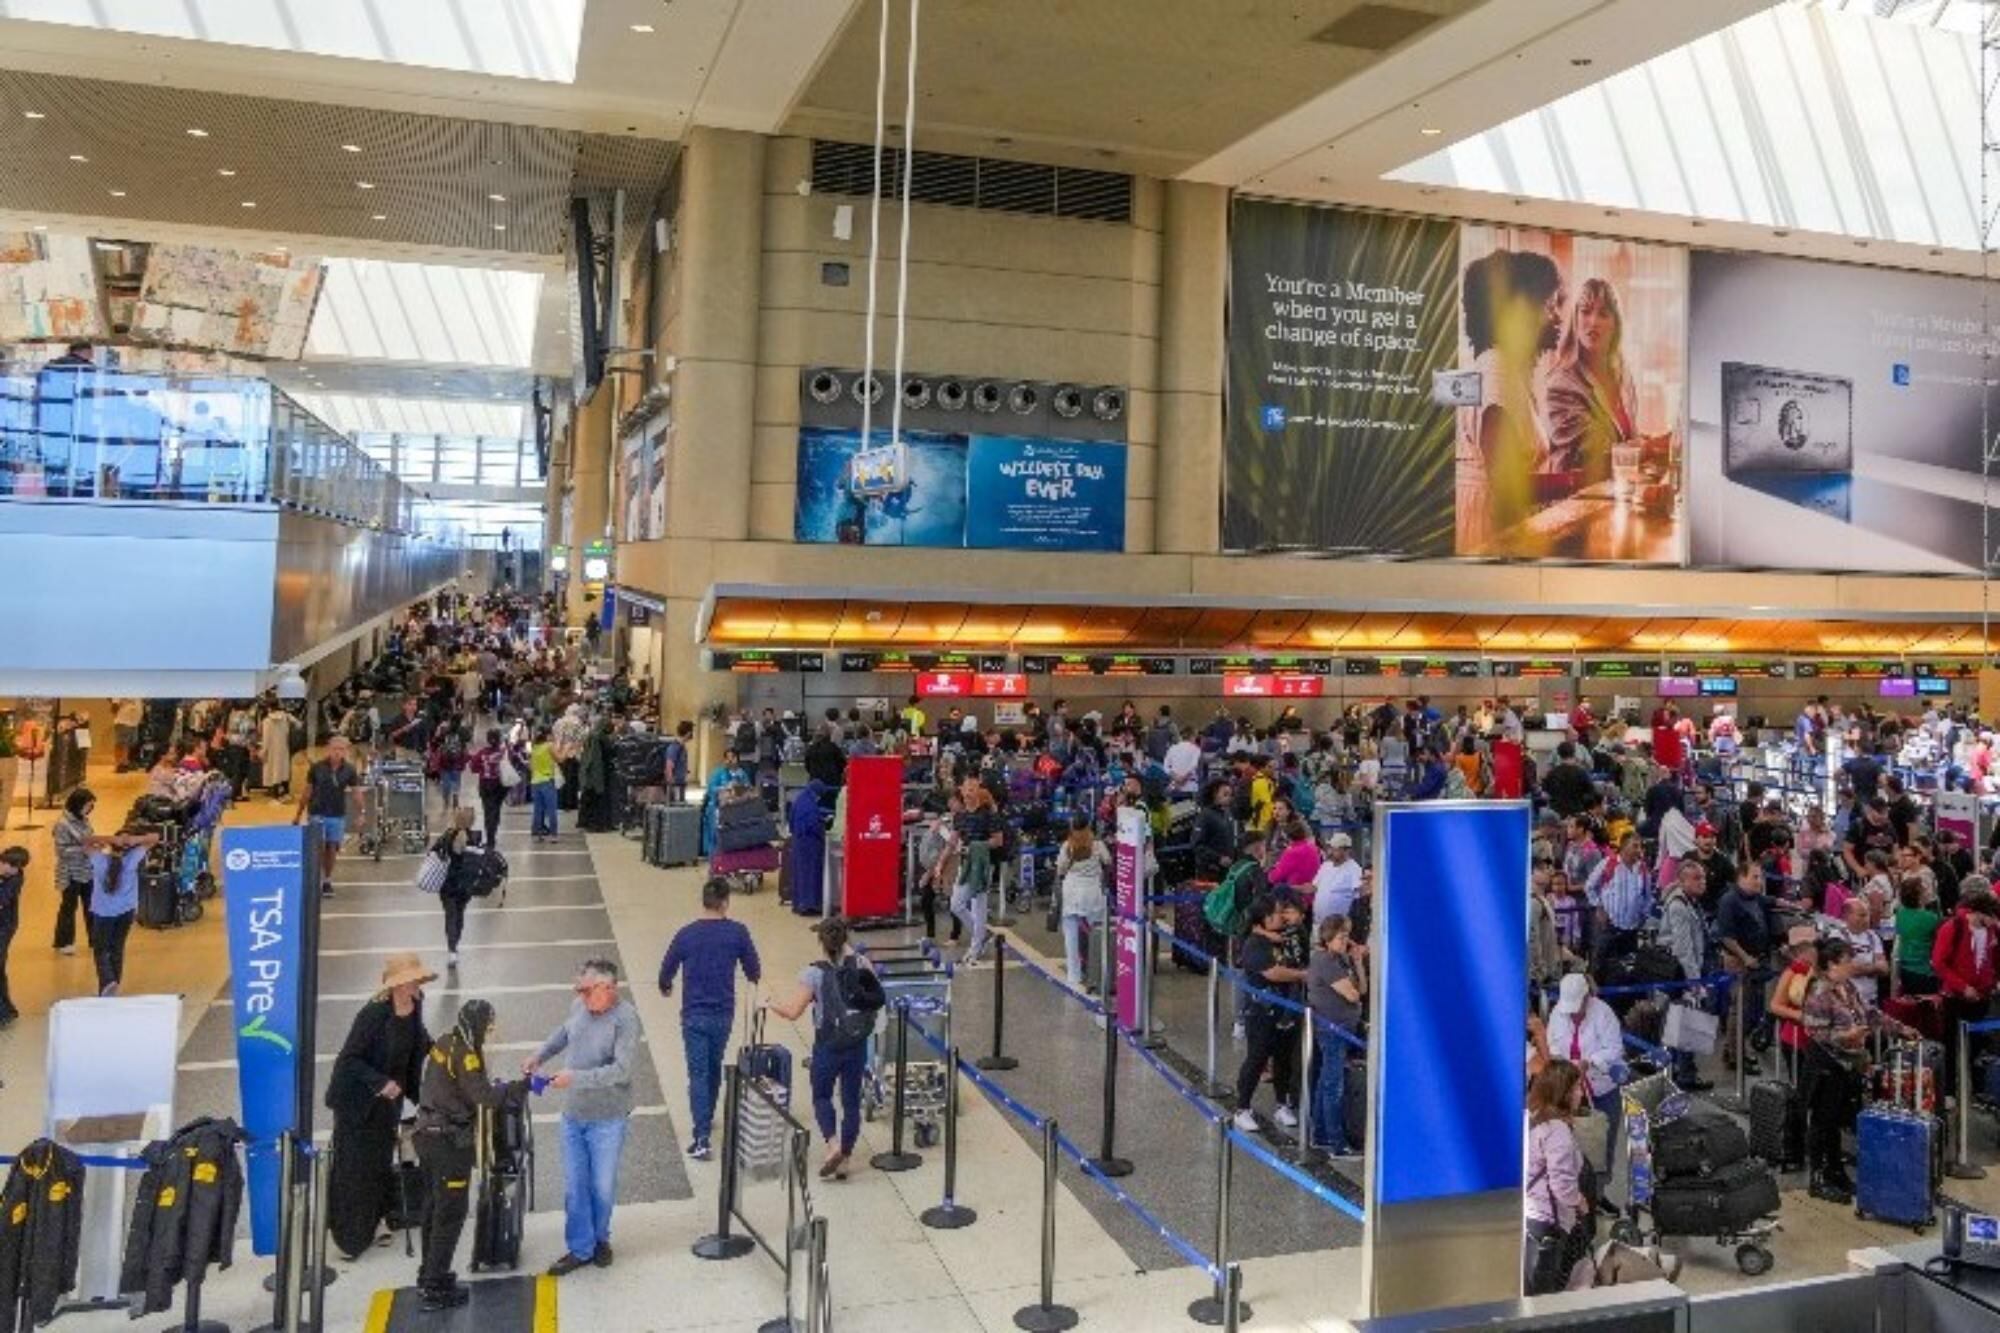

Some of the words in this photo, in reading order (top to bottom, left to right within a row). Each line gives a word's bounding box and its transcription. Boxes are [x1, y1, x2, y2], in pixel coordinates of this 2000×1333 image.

[1265, 273, 1327, 298] You're
[1330, 283, 1341, 298] a
[1346, 281, 1424, 305] Member
[1272, 299, 1327, 321] when
[1331, 305, 1367, 326] you
[1372, 310, 1400, 329] get
[1406, 314, 1417, 329] a
[1264, 321, 1337, 347] change
[1341, 328, 1362, 347] of
[1025, 478, 1077, 500] EVER
[249, 887, 284, 951] TSA
[246, 960, 281, 1013] Pre
